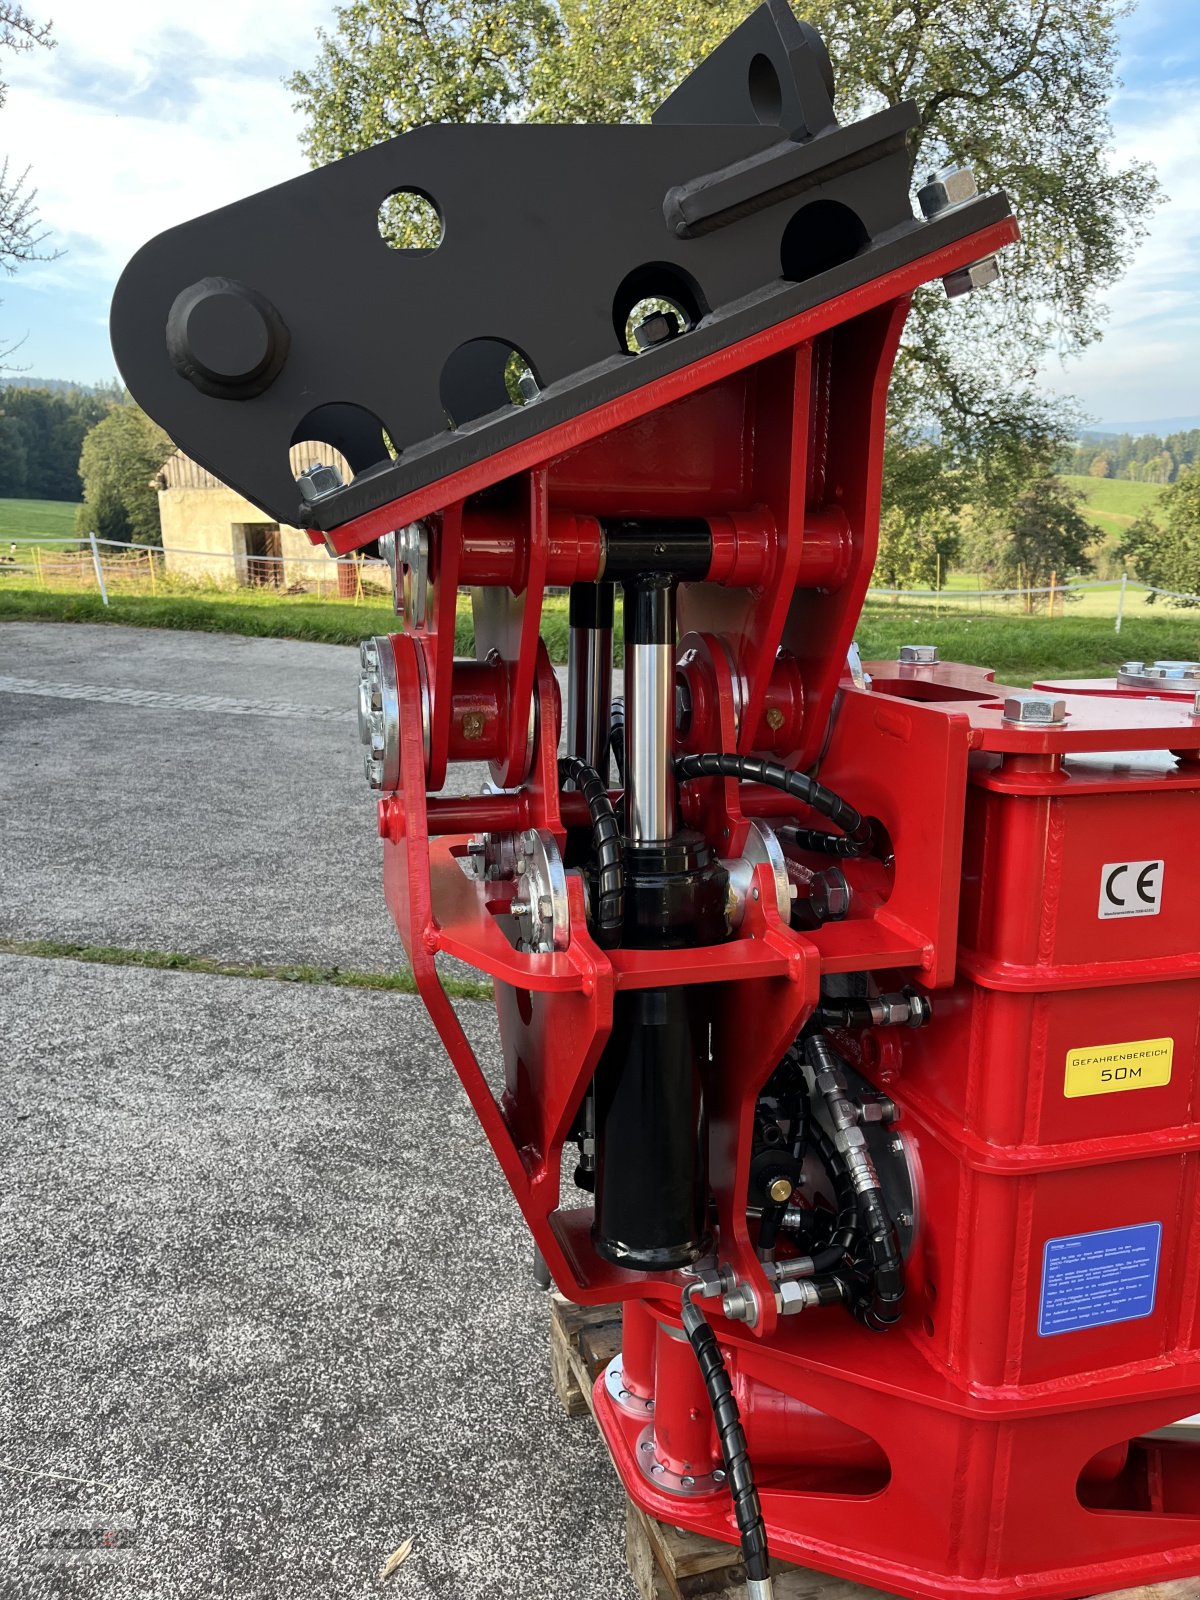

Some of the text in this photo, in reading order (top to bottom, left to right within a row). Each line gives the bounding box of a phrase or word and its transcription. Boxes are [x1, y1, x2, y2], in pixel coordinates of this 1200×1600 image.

[1106, 863, 1158, 906] CE
[1072, 1049, 1168, 1067] GEFAHRENBEREICH
[1101, 1067, 1142, 1082] 50M
